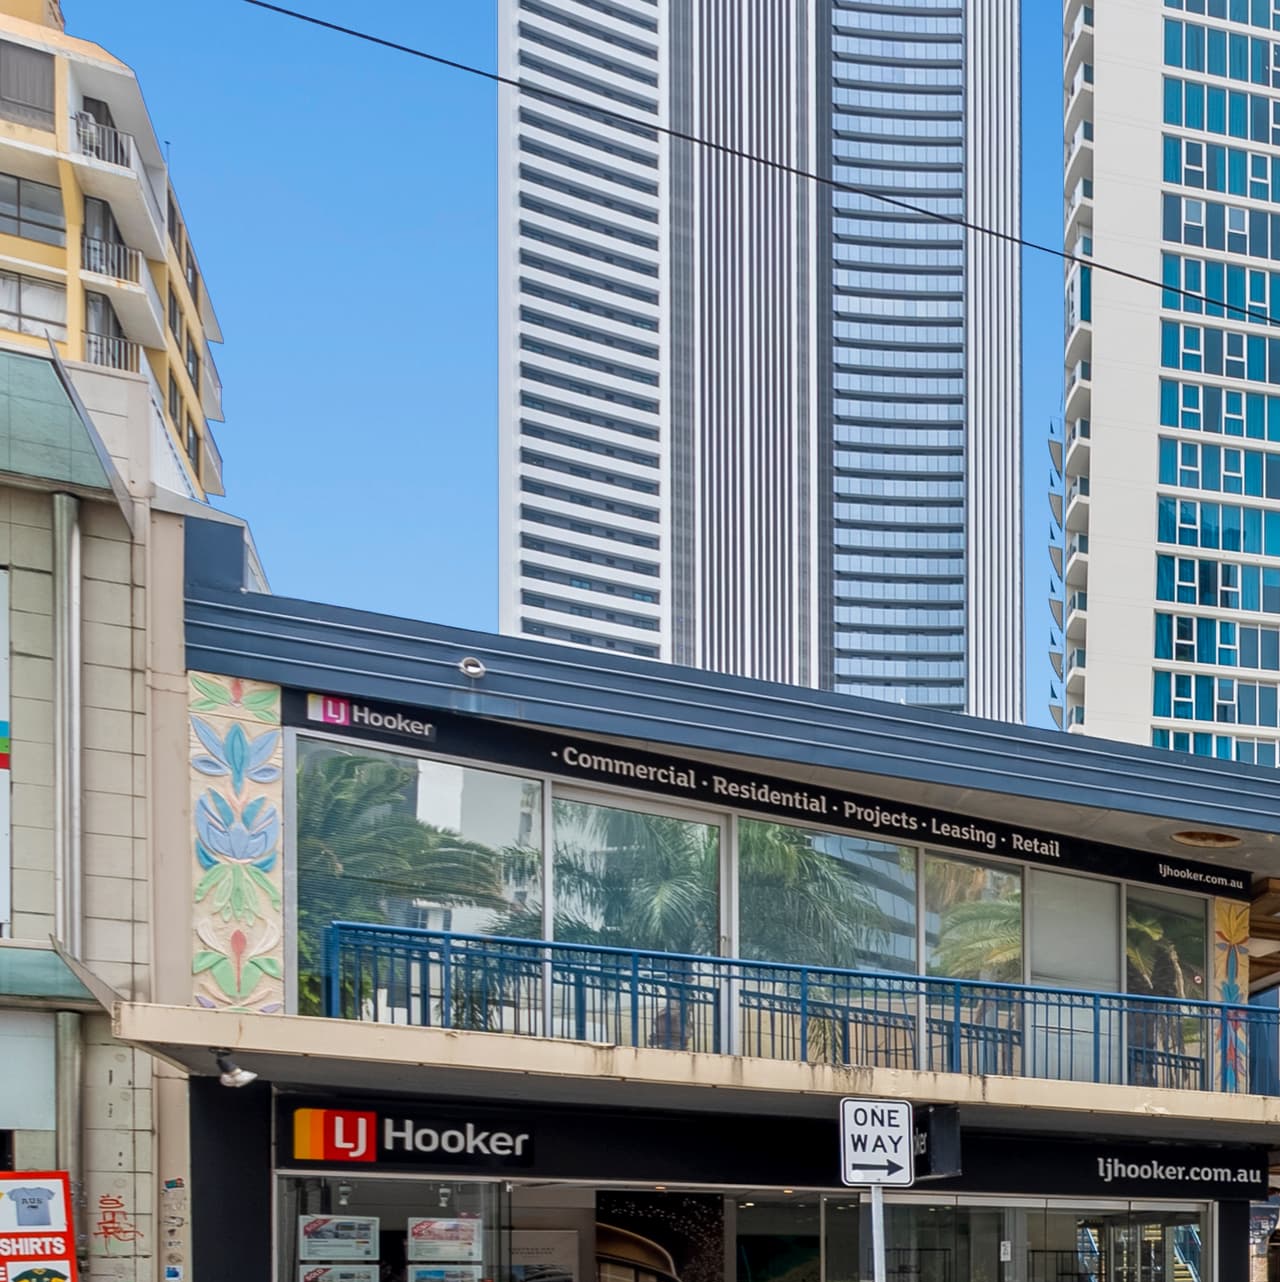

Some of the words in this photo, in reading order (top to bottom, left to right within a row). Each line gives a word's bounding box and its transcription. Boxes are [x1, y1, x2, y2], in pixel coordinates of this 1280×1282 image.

[324, 697, 348, 724] LJ
[352, 704, 434, 738] Hooker
[562, 746, 697, 789] Commercial
[712, 774, 827, 814] Residential
[843, 801, 918, 831] Projects
[931, 817, 997, 849] Leasing
[1012, 834, 1061, 858] Retail
[1158, 864, 1244, 890] ljhooker.com.au
[853, 1107, 901, 1128] ONE
[334, 1117, 367, 1158] LJ
[383, 1118, 530, 1157] Hooker
[850, 1133, 904, 1154] WAY
[1098, 1157, 1262, 1185] ljhooker.com.au
